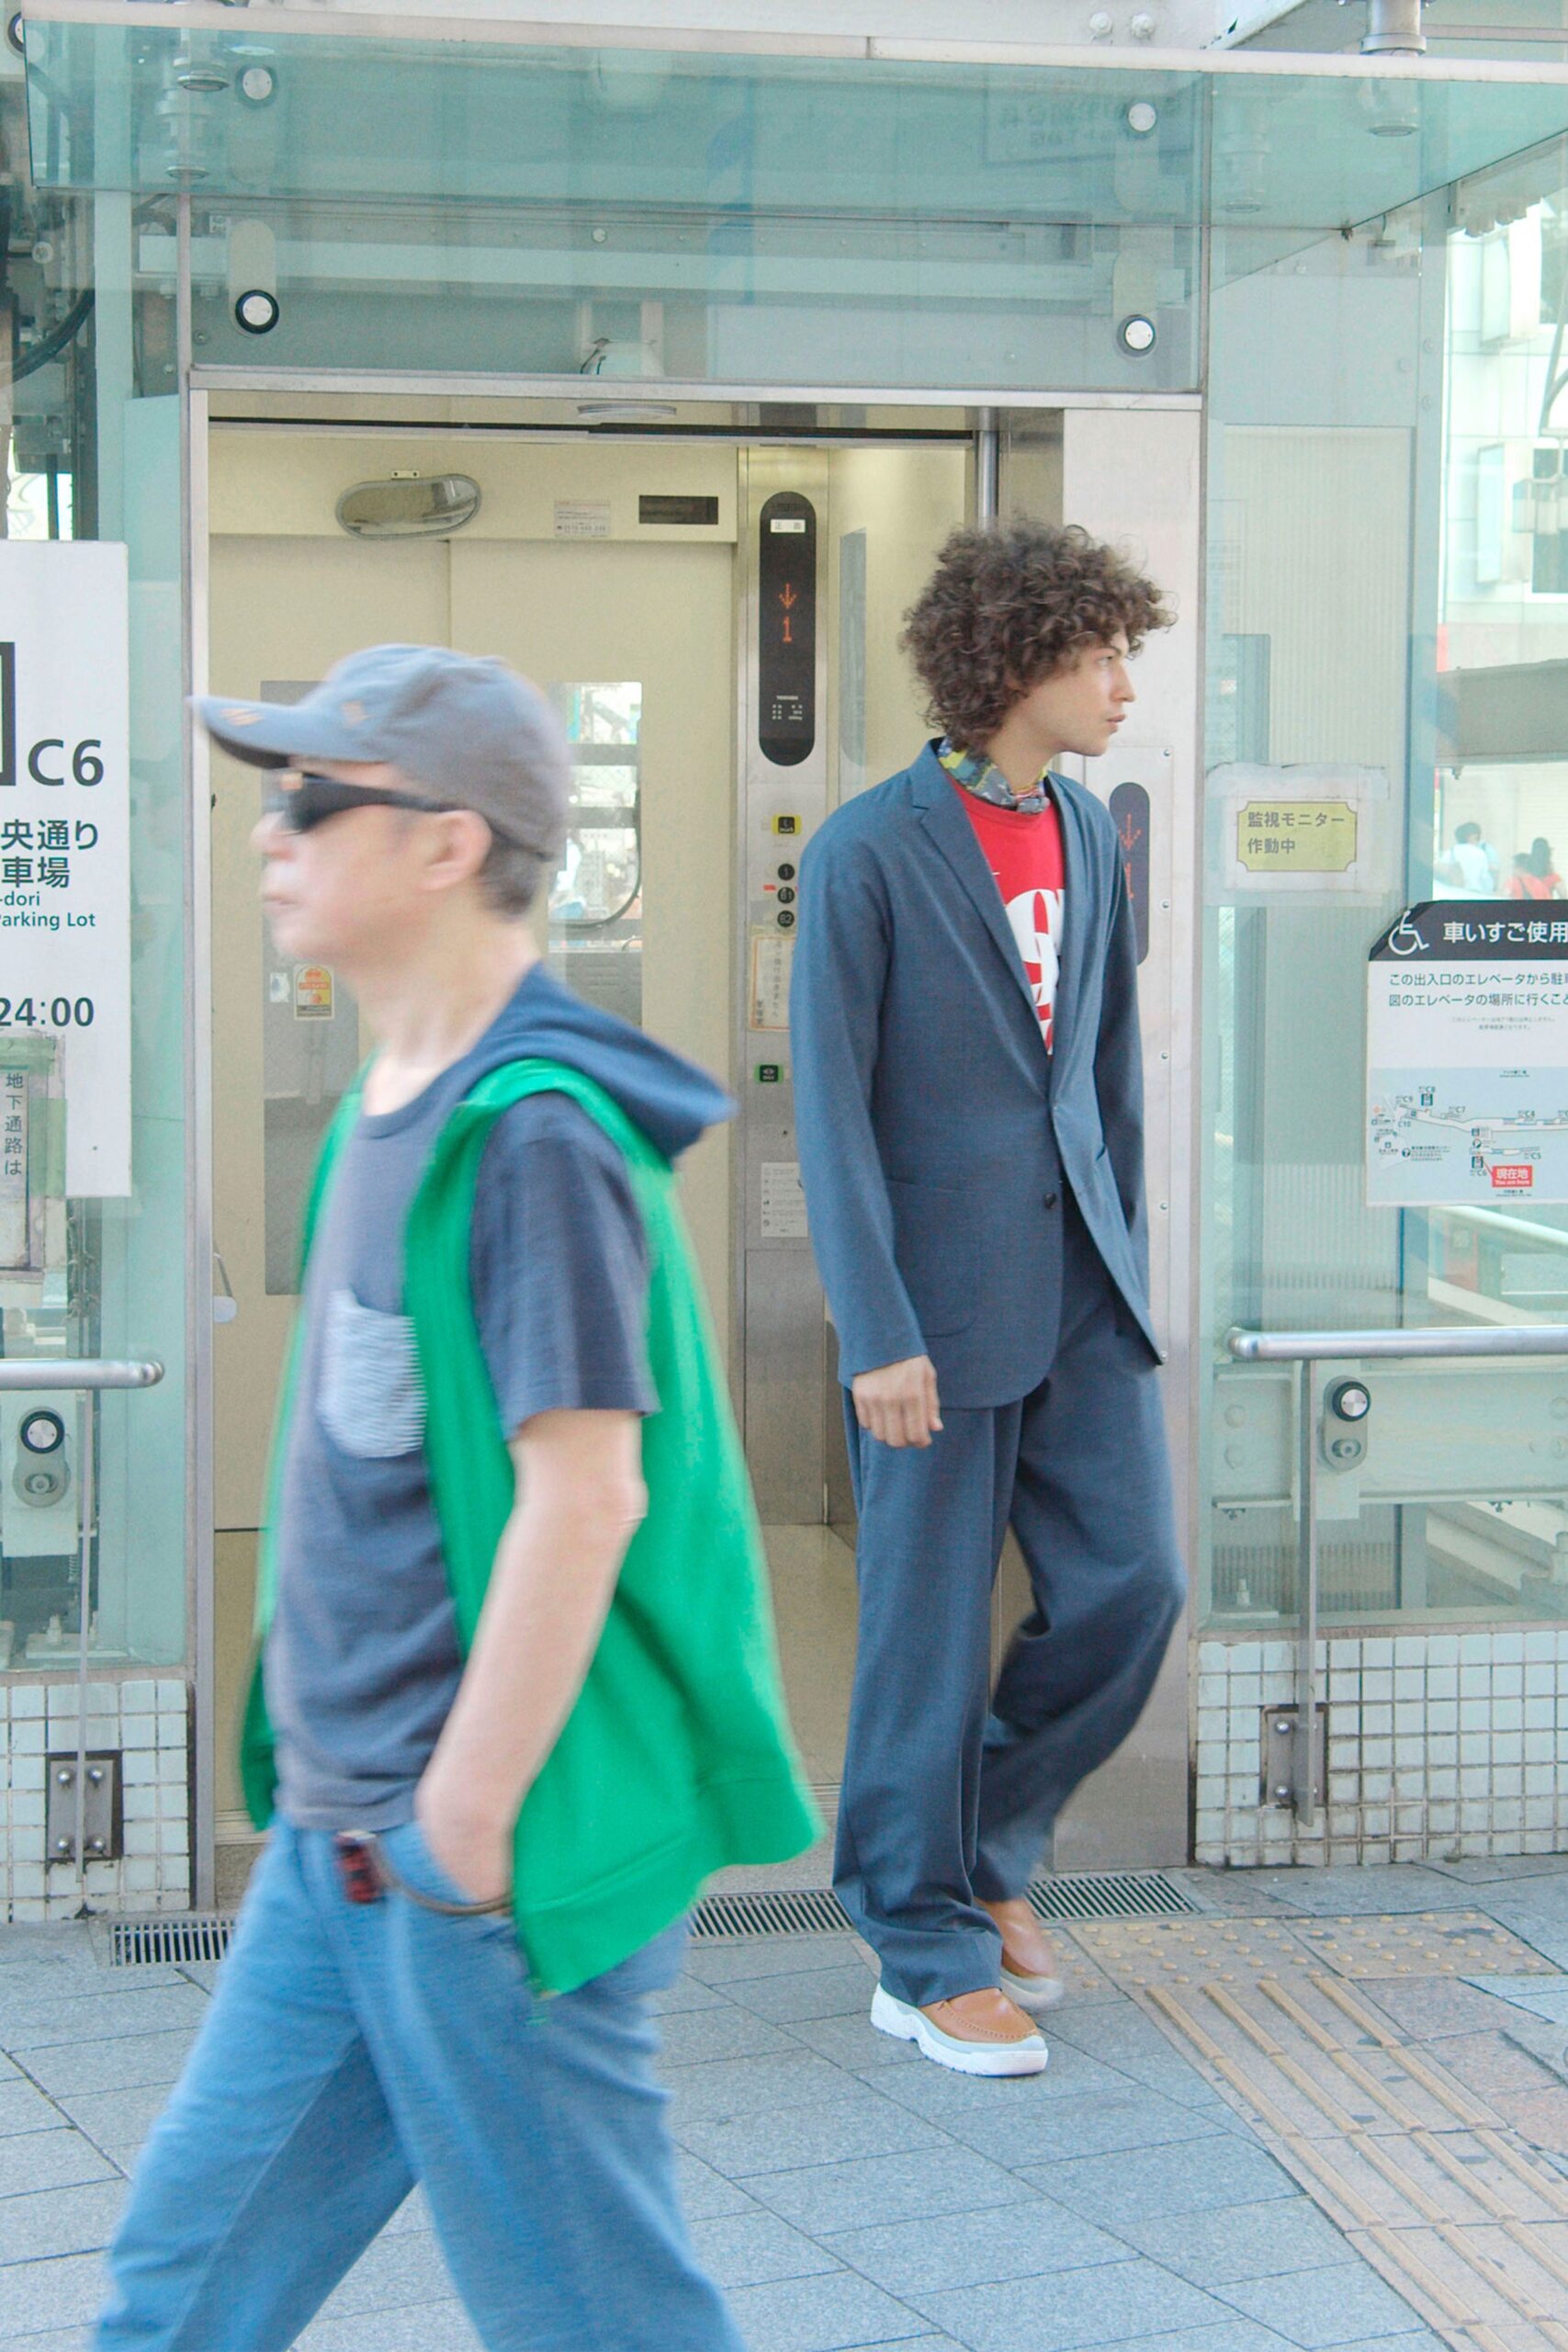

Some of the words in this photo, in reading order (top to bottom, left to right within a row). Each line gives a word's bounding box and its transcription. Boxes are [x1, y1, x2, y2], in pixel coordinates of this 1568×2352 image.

[783, 616, 793, 643] 1
[28, 738, 105, 787] C6
[1247, 811, 1345, 828] 監視モニター
[1247, 837, 1296, 854] 作動中
[0, 911, 61, 931] arking
[67, 911, 96, 927] Lot
[779, 913, 793, 924] B2
[1442, 921, 1568, 944] 車いすご使用
[5, 1072, 24, 1176] 地下通路は
